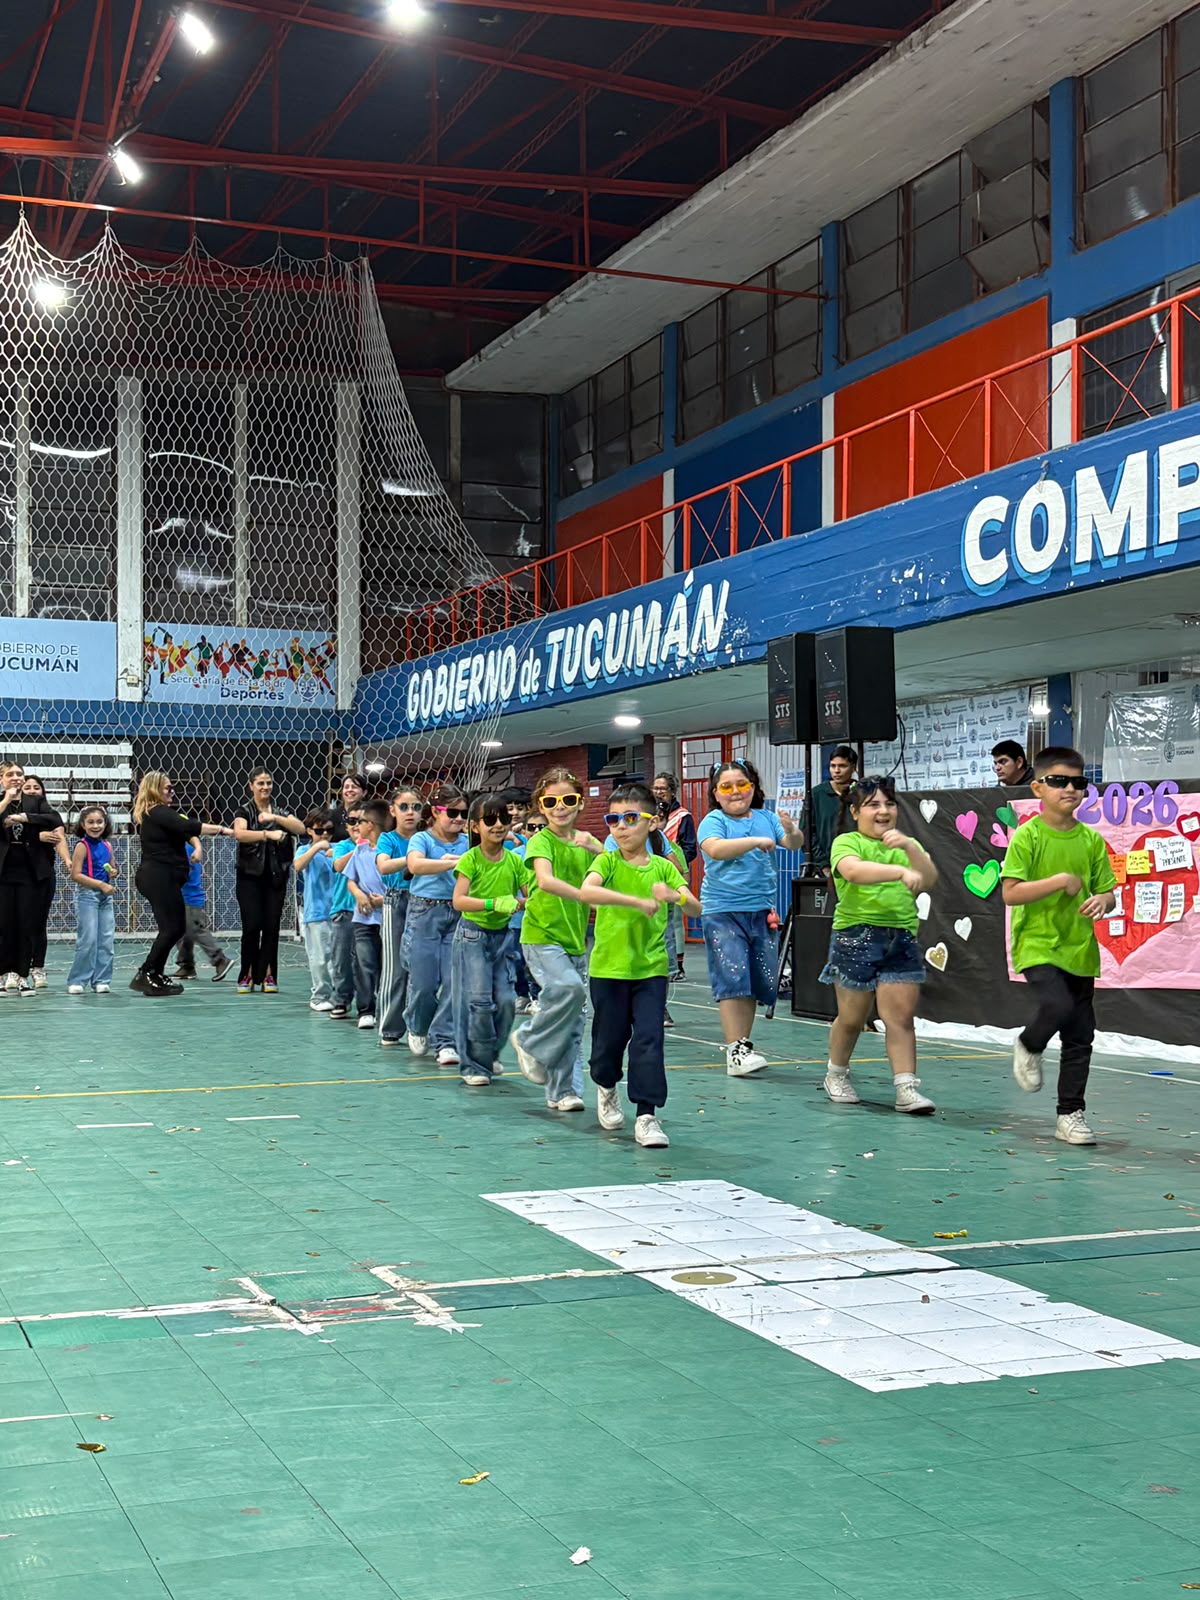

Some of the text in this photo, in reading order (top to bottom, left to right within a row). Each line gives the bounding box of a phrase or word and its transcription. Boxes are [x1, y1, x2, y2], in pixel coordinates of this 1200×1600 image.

[962, 435, 1200, 596] COMP
[0, 642, 78, 656] BIERNO DE
[407, 570, 731, 728] GOBIERNO de TUCUMÁN
[170, 675, 286, 688] Secretaría de Estado de
[220, 687, 285, 701] Deportes
[775, 703, 790, 719] STS
[825, 700, 841, 717] STS
[1077, 780, 1179, 826] 2026
